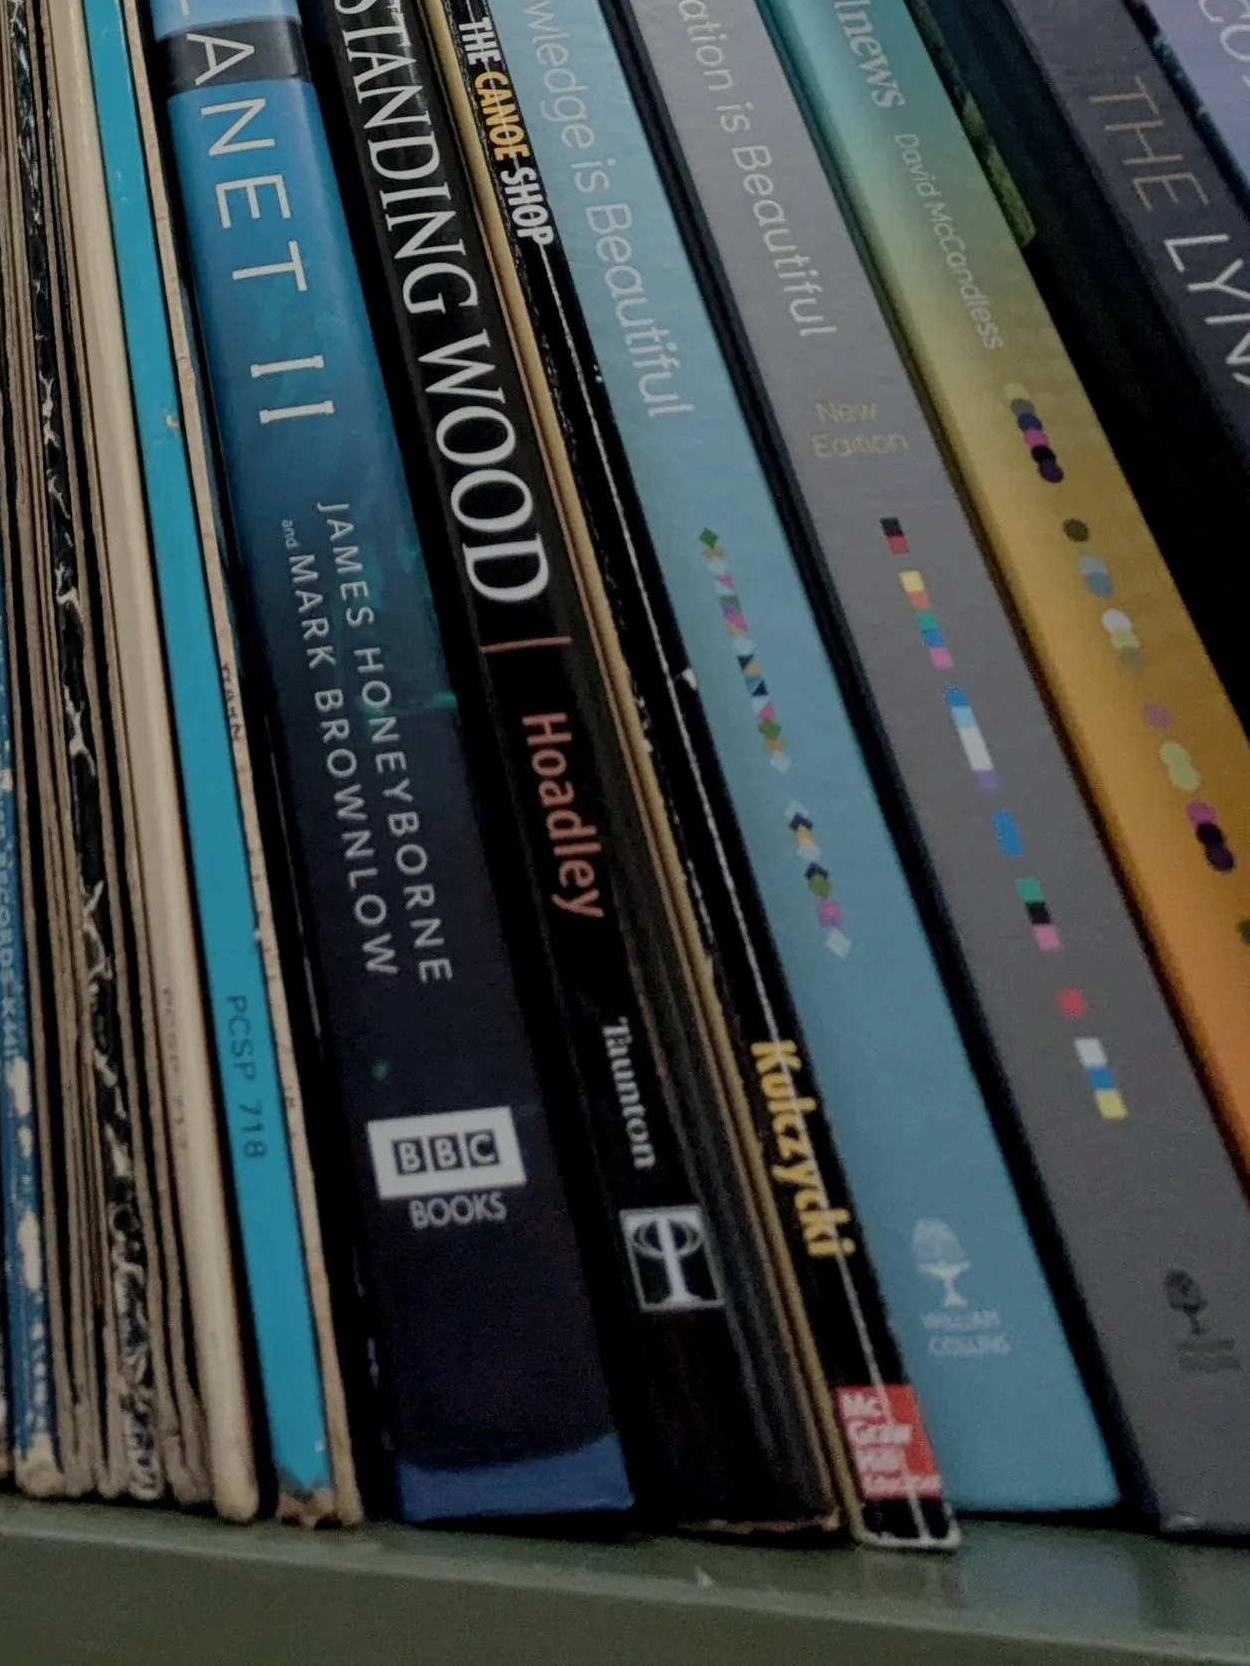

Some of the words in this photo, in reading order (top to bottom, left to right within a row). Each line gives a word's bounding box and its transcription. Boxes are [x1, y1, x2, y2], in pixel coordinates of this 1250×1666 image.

[458, 16, 501, 65] THE
[473, 68, 531, 161] CANOE
[715, 102, 755, 134] is
[500, 161, 555, 247] SHOP
[571, 158, 610, 193] is
[733, 144, 837, 339] Beautiful
[895, 133, 942, 198] David
[924, 201, 1004, 350] McCandless
[1089, 75, 1210, 212] THE
[1163, 233, 1250, 386] LYN
[585, 204, 693, 417] Beautiful
[250, 355, 335, 424] II
[815, 401, 877, 425] New
[418, 329, 549, 603] WOOD
[811, 432, 909, 460] Edition
[280, 518, 297, 551] and
[290, 553, 336, 671] MARK
[315, 687, 400, 975] BROWNLOW
[316, 501, 375, 628] JAMES
[354, 646, 453, 983] HONEYBORNE
[522, 712, 606, 919] Hoadley
[225, 994, 258, 1082] PCSP
[237, 1100, 269, 1159] 718
[602, 1016, 657, 1171] Taunton
[393, 1129, 501, 1175] BBC
[751, 1039, 855, 1259] Kulczycki
[407, 1191, 508, 1231] BOOKS
